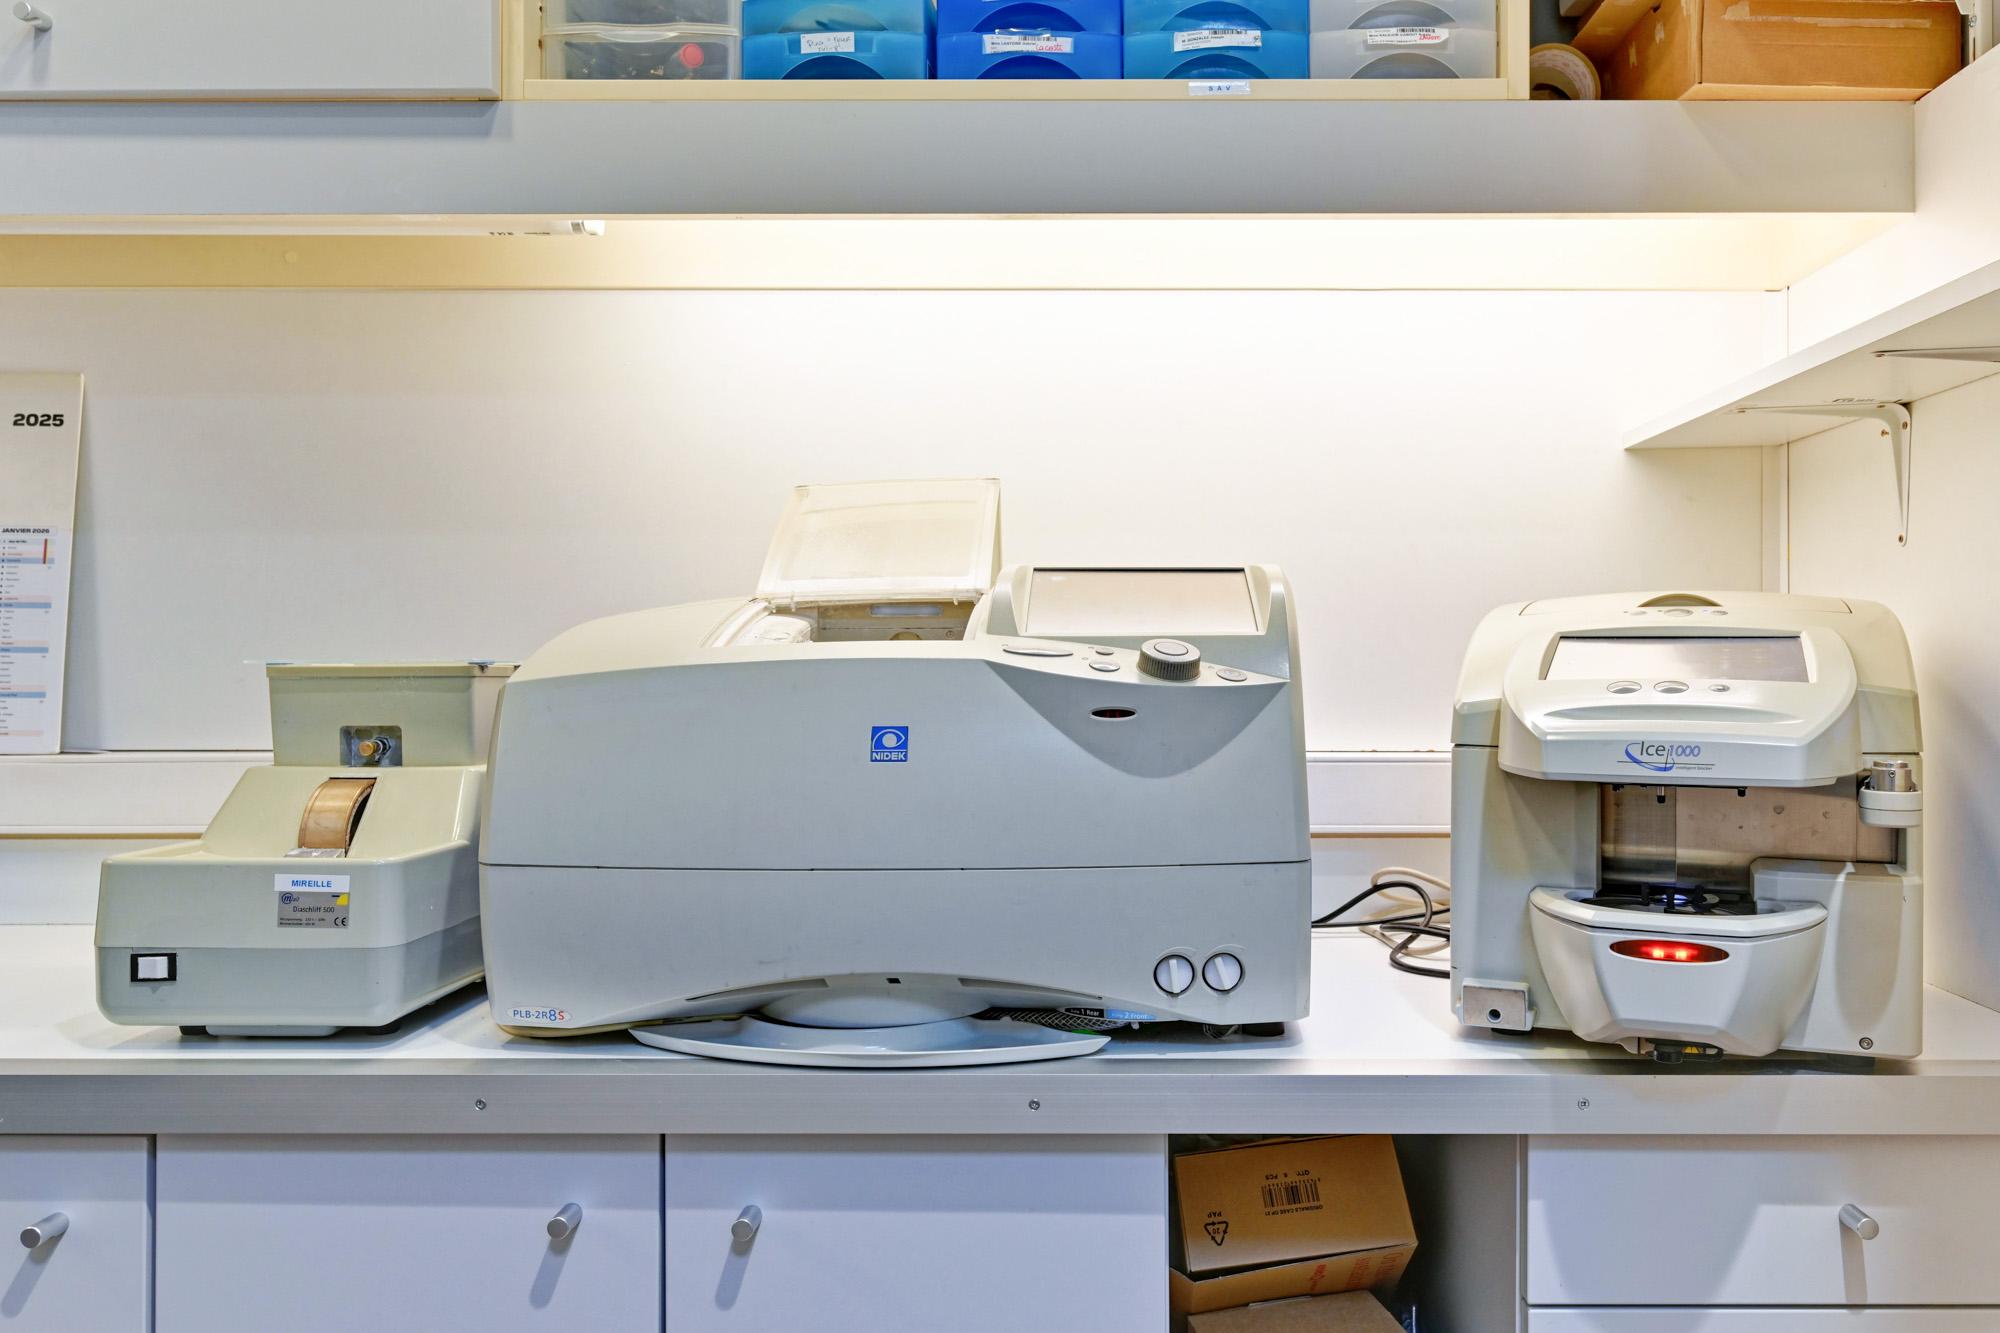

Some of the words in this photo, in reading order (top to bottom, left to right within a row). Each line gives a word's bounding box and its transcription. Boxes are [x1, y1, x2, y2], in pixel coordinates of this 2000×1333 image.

[13, 413, 64, 427] 2025
[1640, 740, 1666, 757] Ice
[1668, 744, 1701, 757] 1000
[872, 752, 906, 760] NIDEK
[291, 880, 333, 888] MIREILLE
